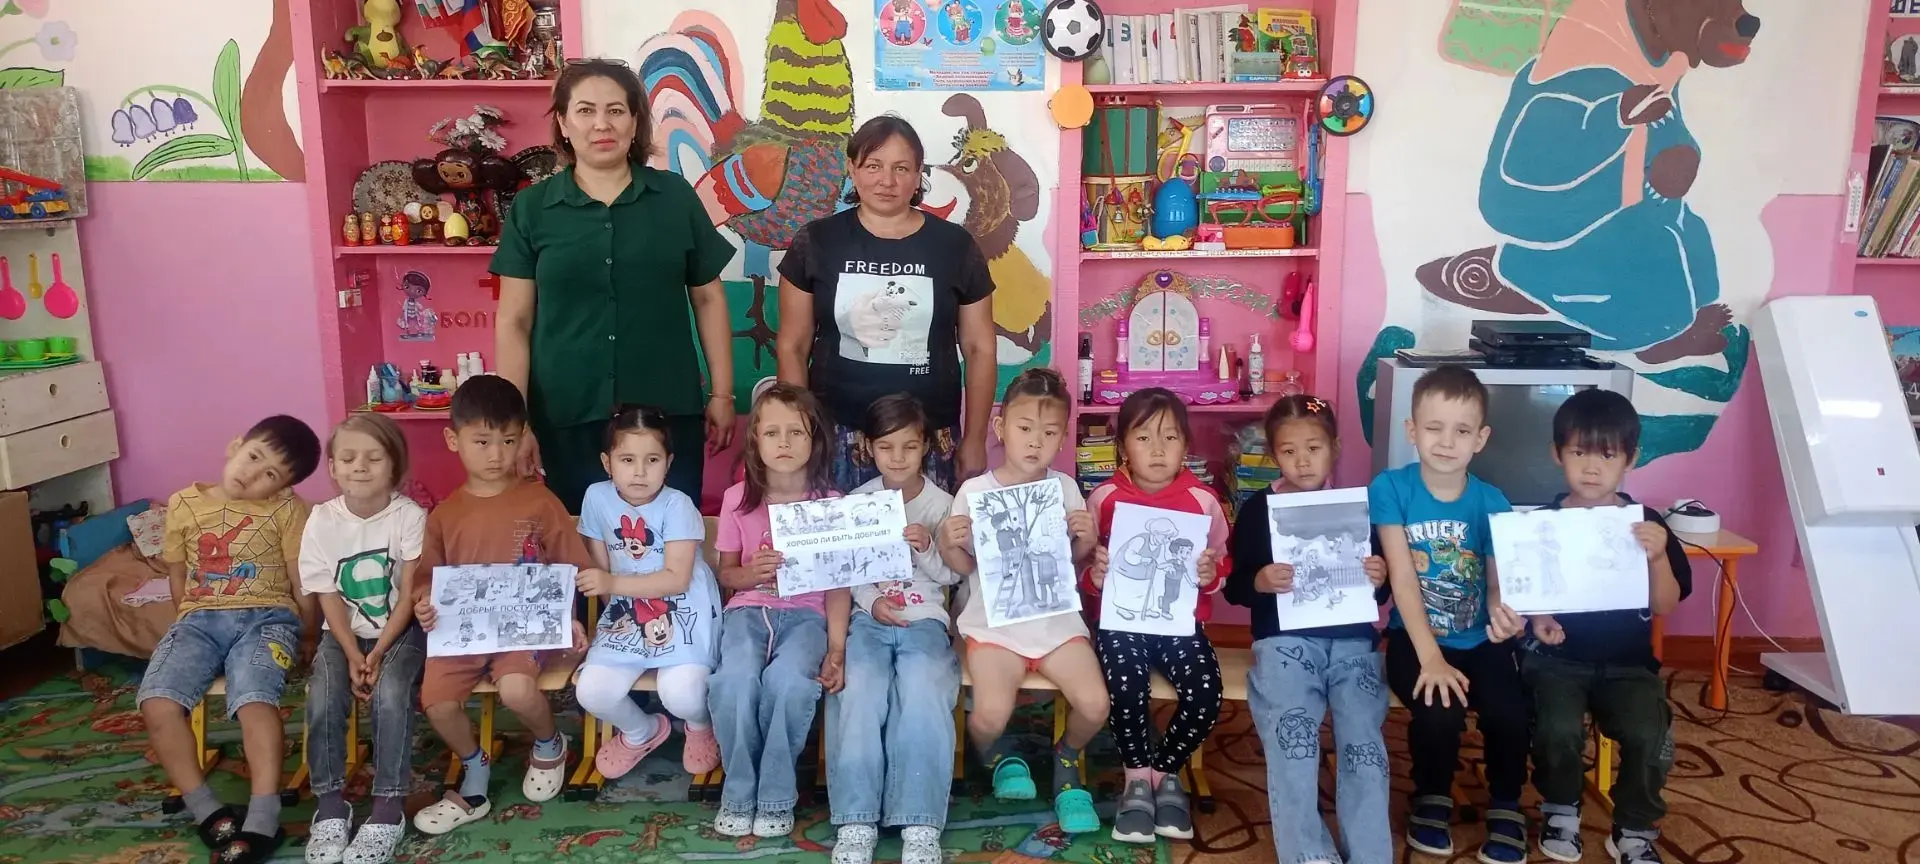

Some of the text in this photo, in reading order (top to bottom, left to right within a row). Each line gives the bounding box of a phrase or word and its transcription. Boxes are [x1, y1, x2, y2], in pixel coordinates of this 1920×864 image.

[844, 260, 925, 275] FREEDOM
[909, 366, 930, 375] FREE
[786, 538, 819, 548] ХОРОШО
[820, 536, 831, 544] ЛИ
[832, 534, 853, 543] БЫТЬ
[458, 603, 549, 616] ДОБРЫЕ ПОСТУПКИ
[601, 642, 629, 654] SINCE
